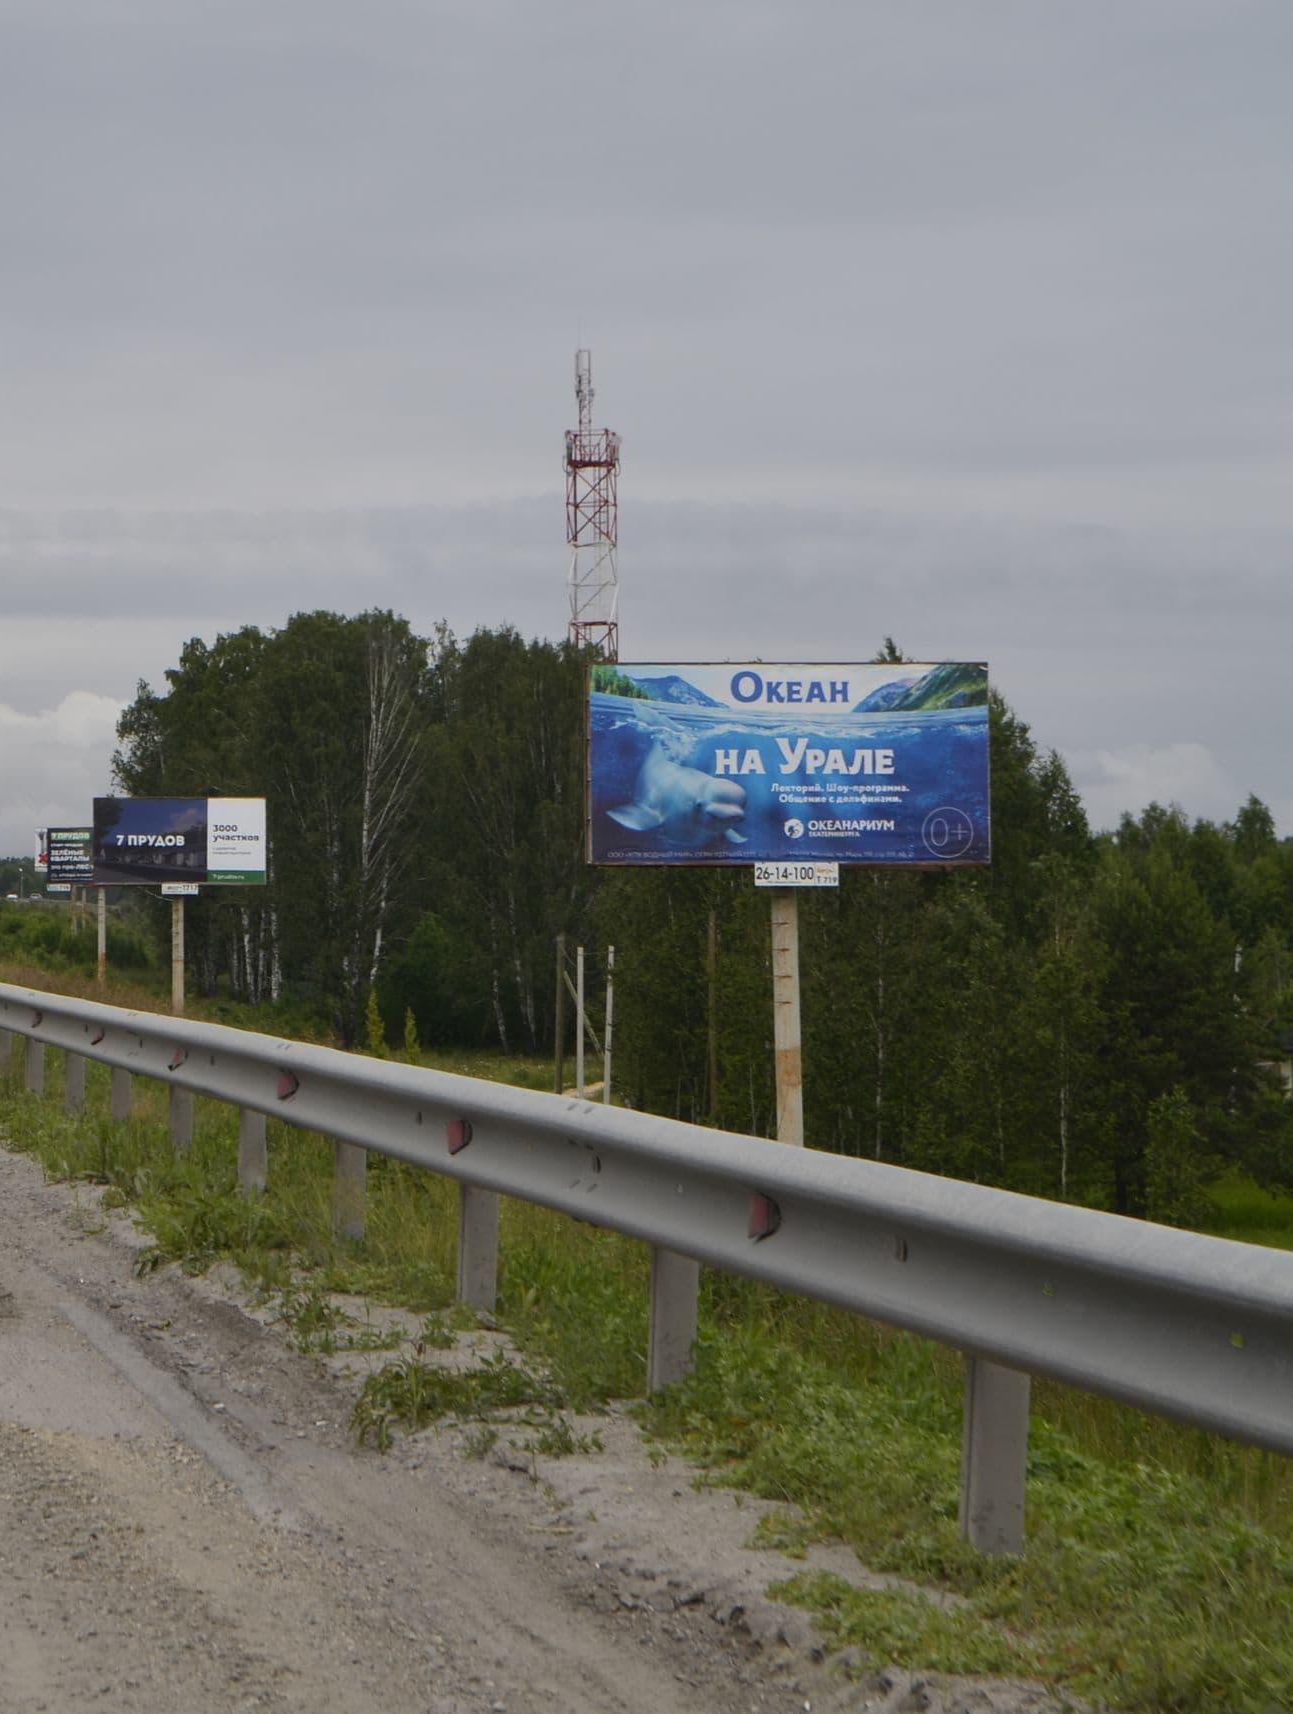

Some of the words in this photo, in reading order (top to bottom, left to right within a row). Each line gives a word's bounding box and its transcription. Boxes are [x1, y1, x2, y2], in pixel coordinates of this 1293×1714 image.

[715, 748, 766, 775] НА
[213, 824, 238, 832] 3000
[808, 820, 895, 831] ОКЕАНАРИУМ
[117, 835, 124, 846] 7
[128, 835, 185, 847] ПРУДОВ
[756, 867, 814, 880] 26-14-100
